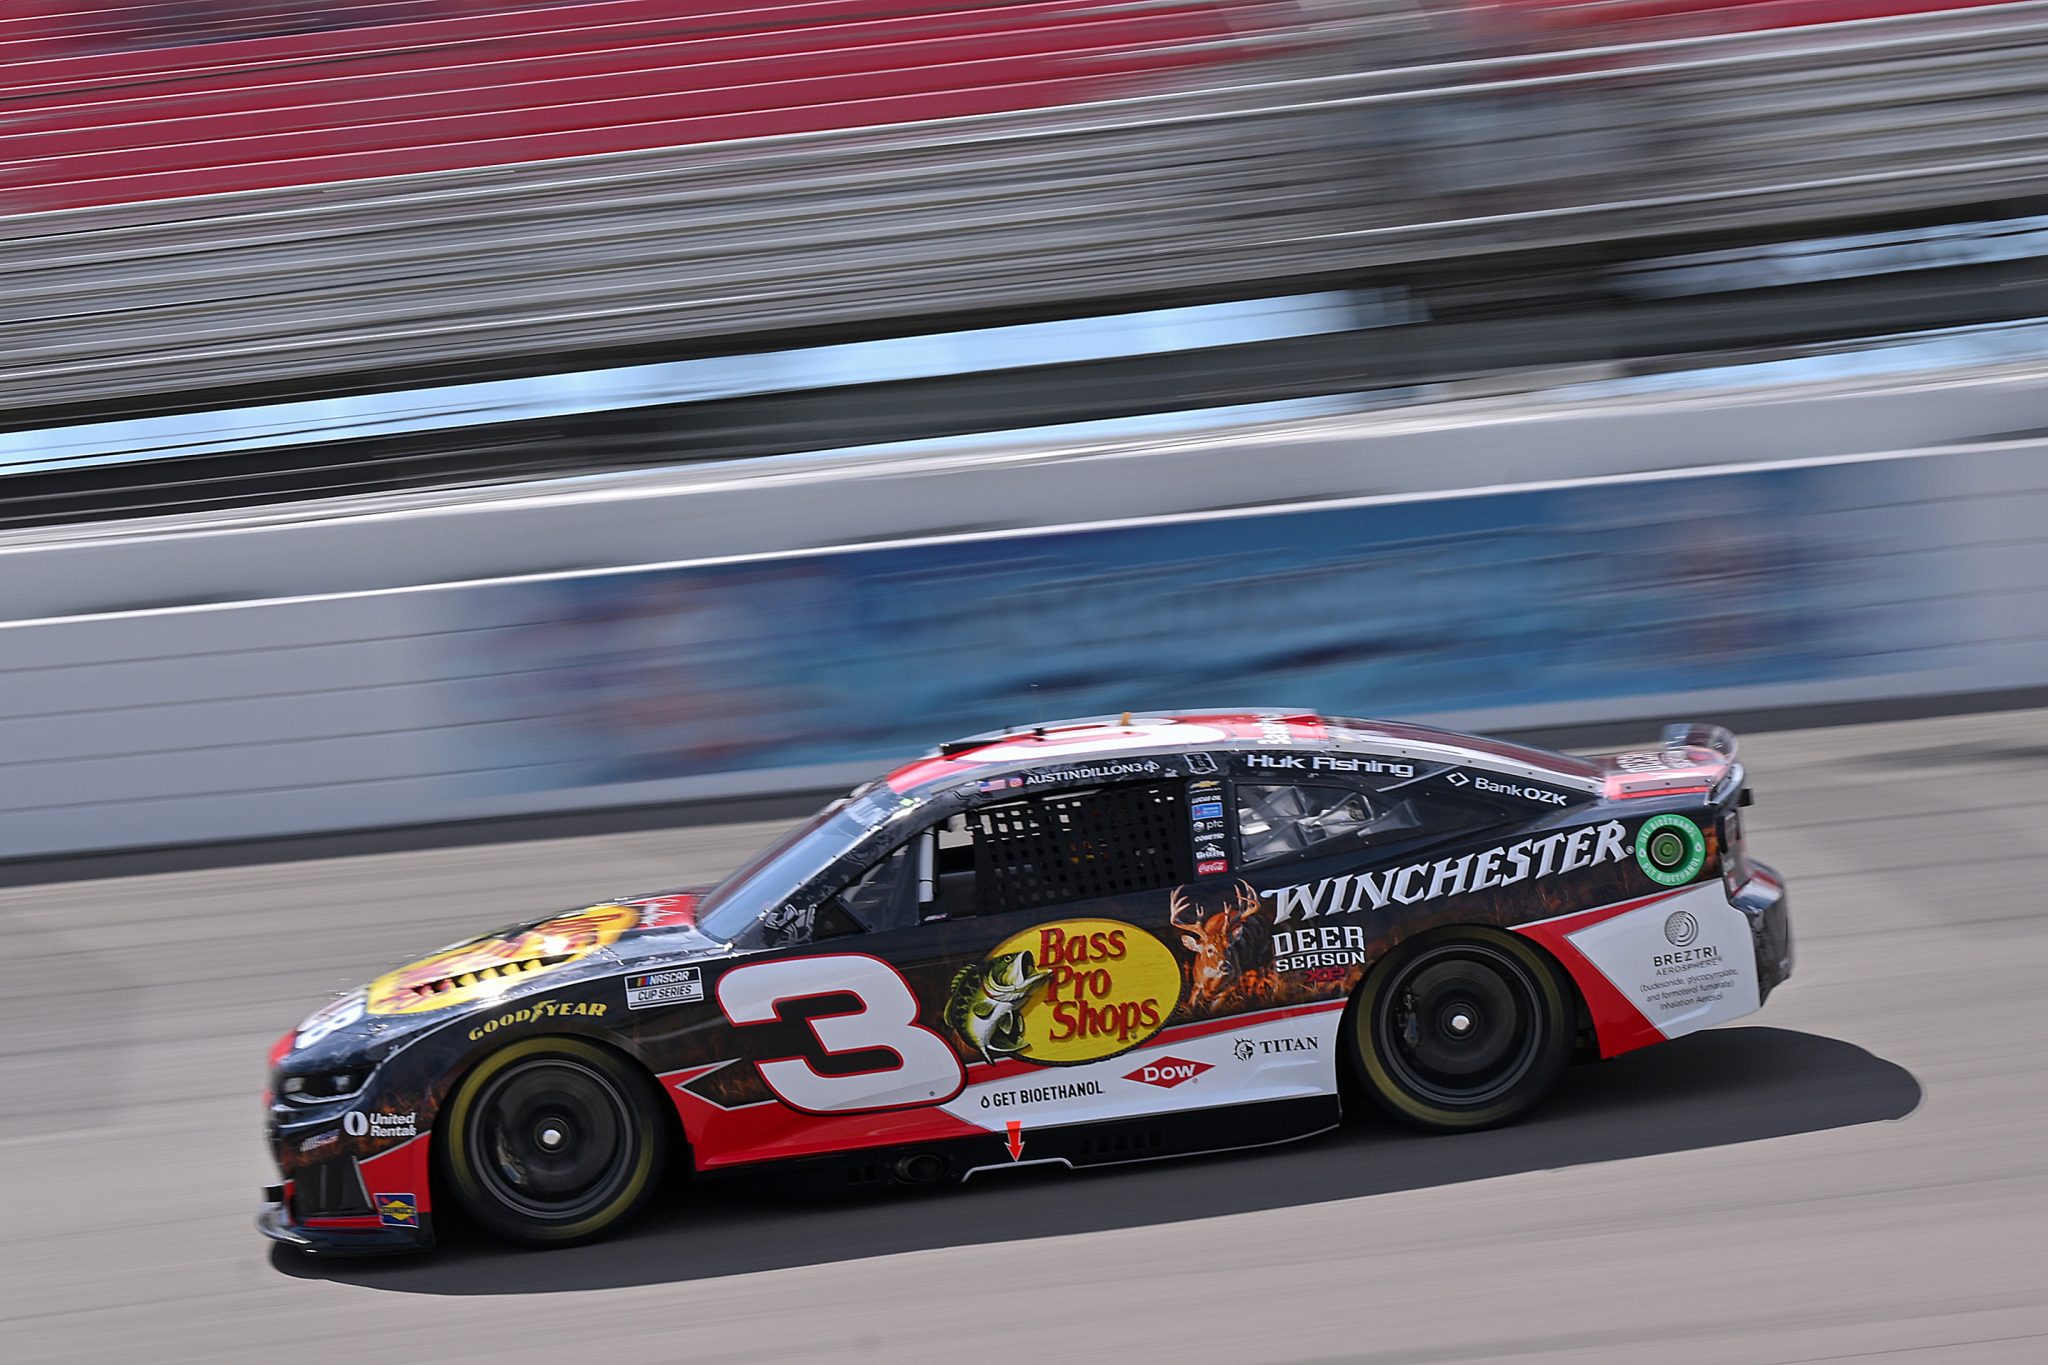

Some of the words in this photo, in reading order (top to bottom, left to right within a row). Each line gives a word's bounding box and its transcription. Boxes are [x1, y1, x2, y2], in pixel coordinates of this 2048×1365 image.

[1247, 754, 1305, 770] Huk
[1312, 756, 1414, 778] Fishing
[1260, 819, 1627, 925] WINCHESTER
[1037, 928, 1127, 969] Bass
[1272, 926, 1365, 956] DEER
[1275, 951, 1366, 973] SEASON
[1653, 946, 1718, 967] BREZTRI
[649, 971, 690, 985] NASCAR
[1043, 965, 1112, 1003] Pro
[637, 987, 660, 1000] CUP
[659, 985, 692, 998] SERIES
[1049, 998, 1160, 1042] Shops
[715, 952, 967, 1116] 3
[1259, 1037, 1318, 1054] TITAN
[993, 1090, 1016, 1107] GET
[1020, 1081, 1102, 1104] BIOETHANOL
[369, 1113, 416, 1125] United
[370, 1124, 417, 1137] Rentals
